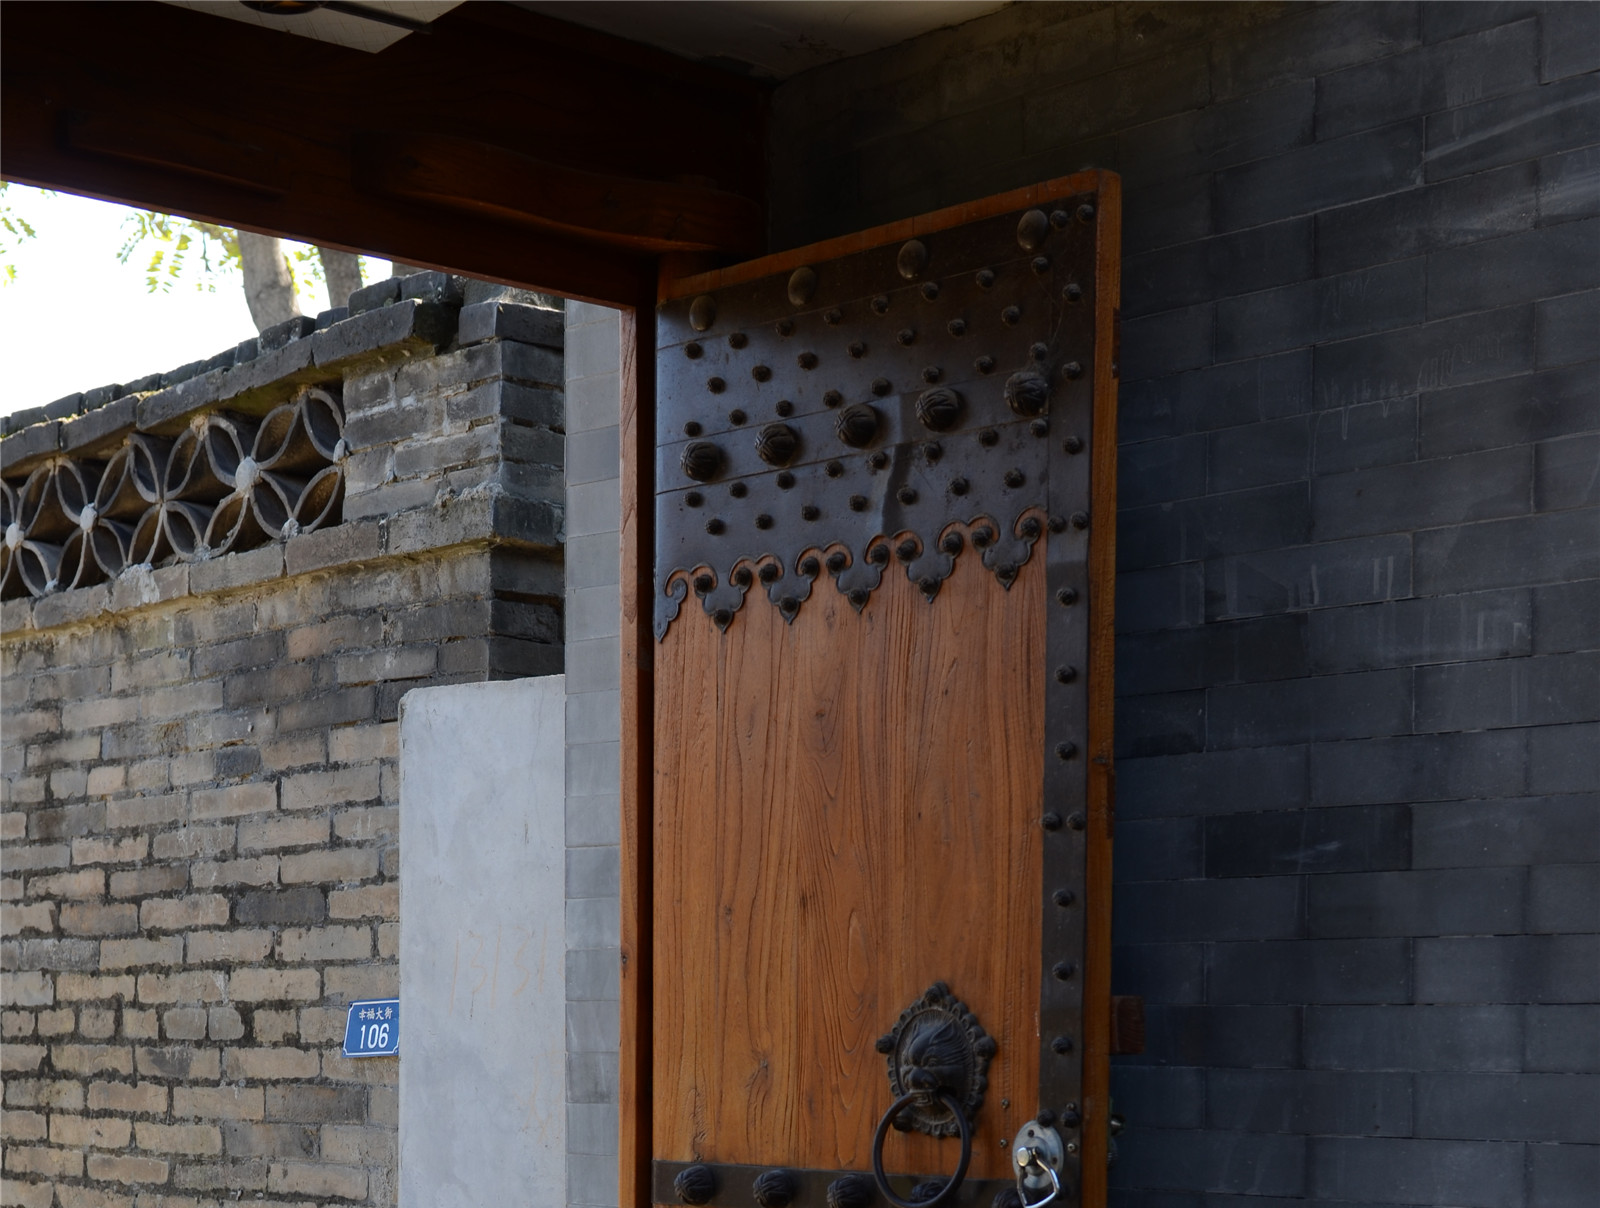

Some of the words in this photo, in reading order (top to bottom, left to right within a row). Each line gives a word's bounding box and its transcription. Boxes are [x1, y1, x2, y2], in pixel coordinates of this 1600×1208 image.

[359, 1006, 393, 1021] 幸福大街
[360, 1023, 389, 1049] 106
